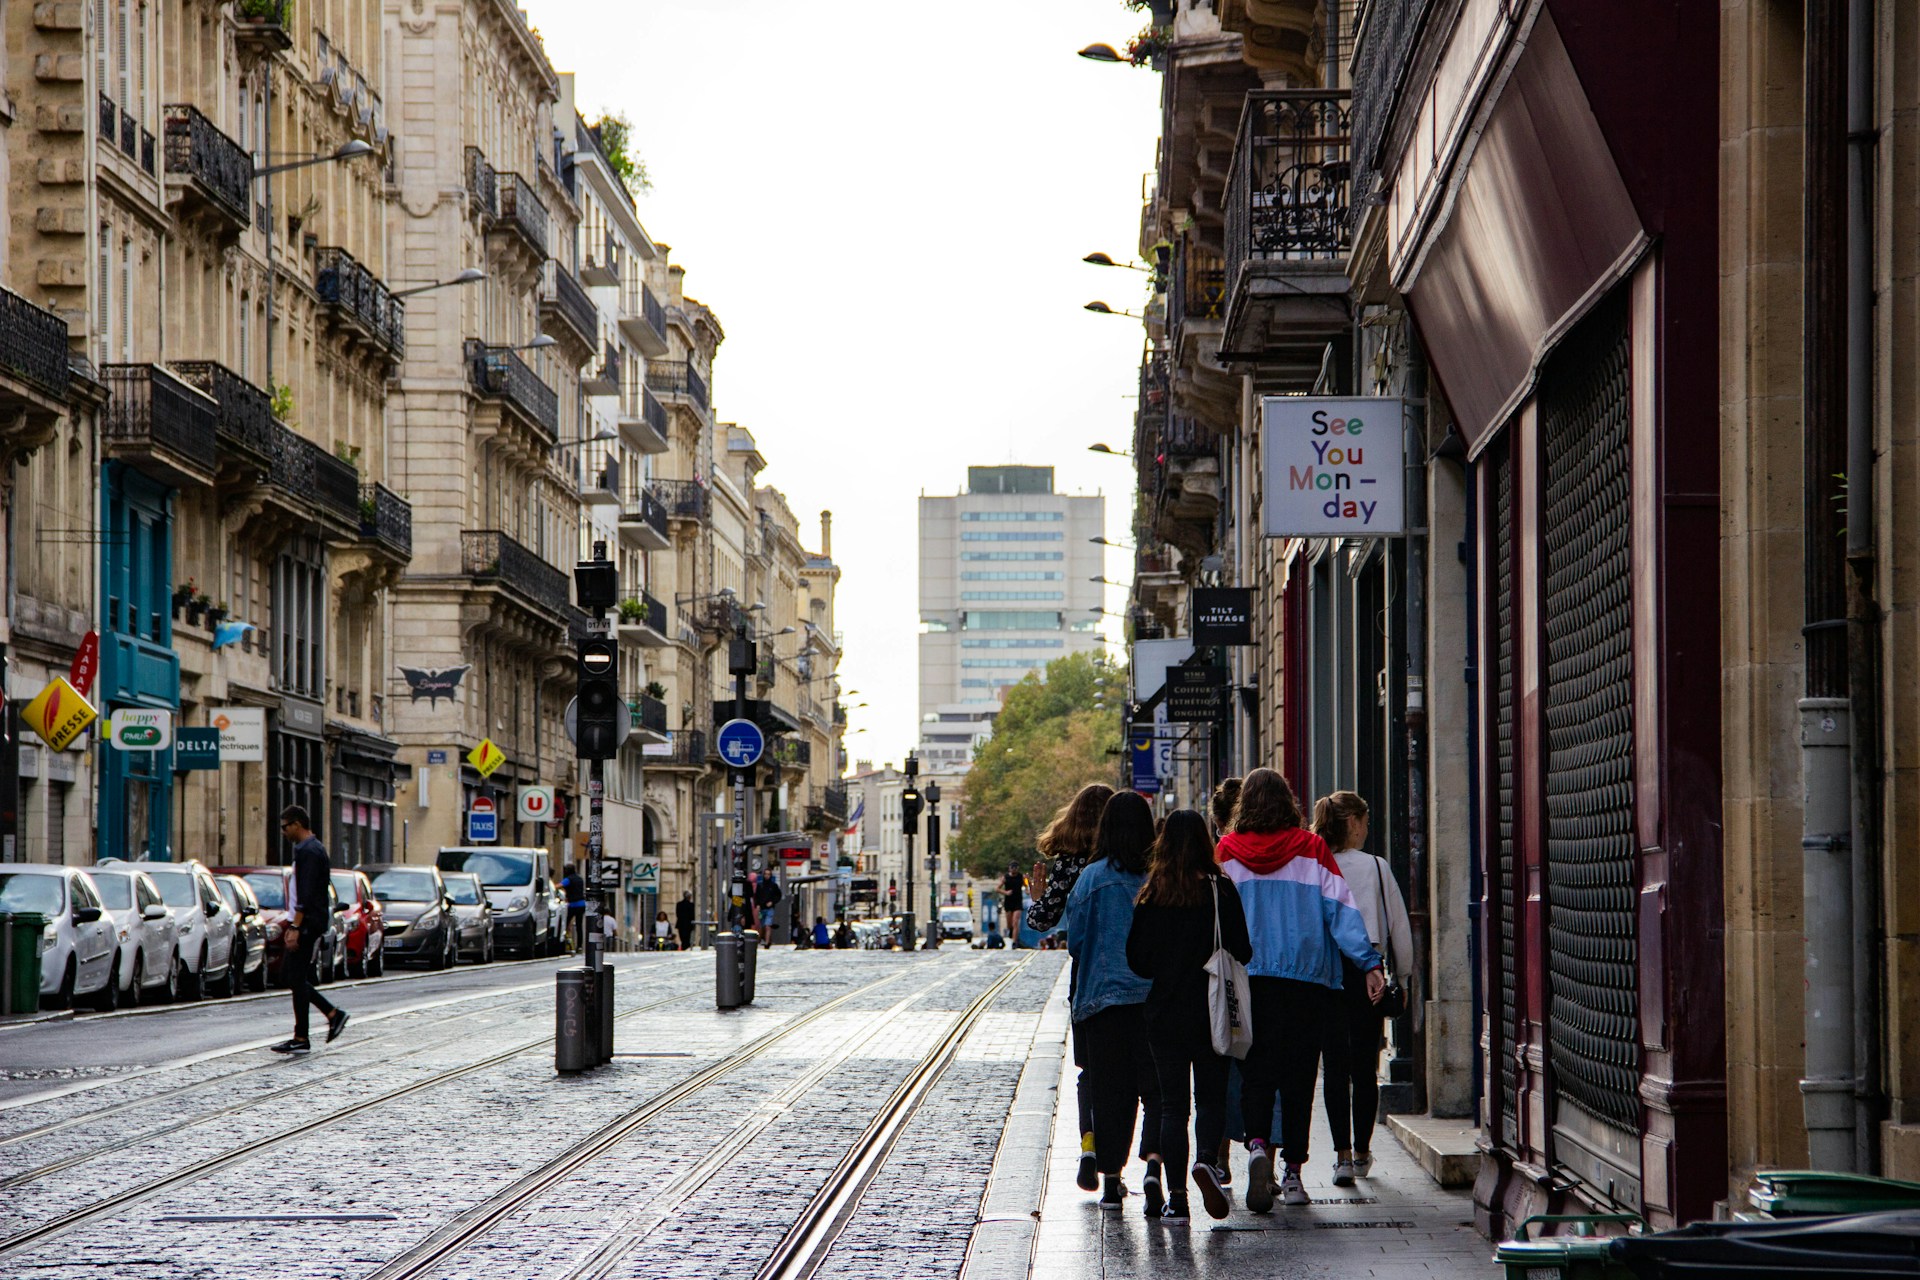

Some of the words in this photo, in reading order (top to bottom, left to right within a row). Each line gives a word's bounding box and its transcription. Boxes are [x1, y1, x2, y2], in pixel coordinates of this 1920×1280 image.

[1311, 410, 1364, 436] See
[1310, 440, 1363, 466] You
[1323, 493, 1377, 525] day
[588, 621, 600, 629] 017
[121, 710, 159, 725] happy
[1174, 709, 1216, 717] ONGLERIE
[51, 708, 89, 747] PRESSE
[177, 740, 217, 751] DELTA
[219, 742, 260, 751] ectriques
[483, 755, 502, 775] PRESSE
[528, 797, 542, 811] U
[472, 822, 494, 831] TAXIS
